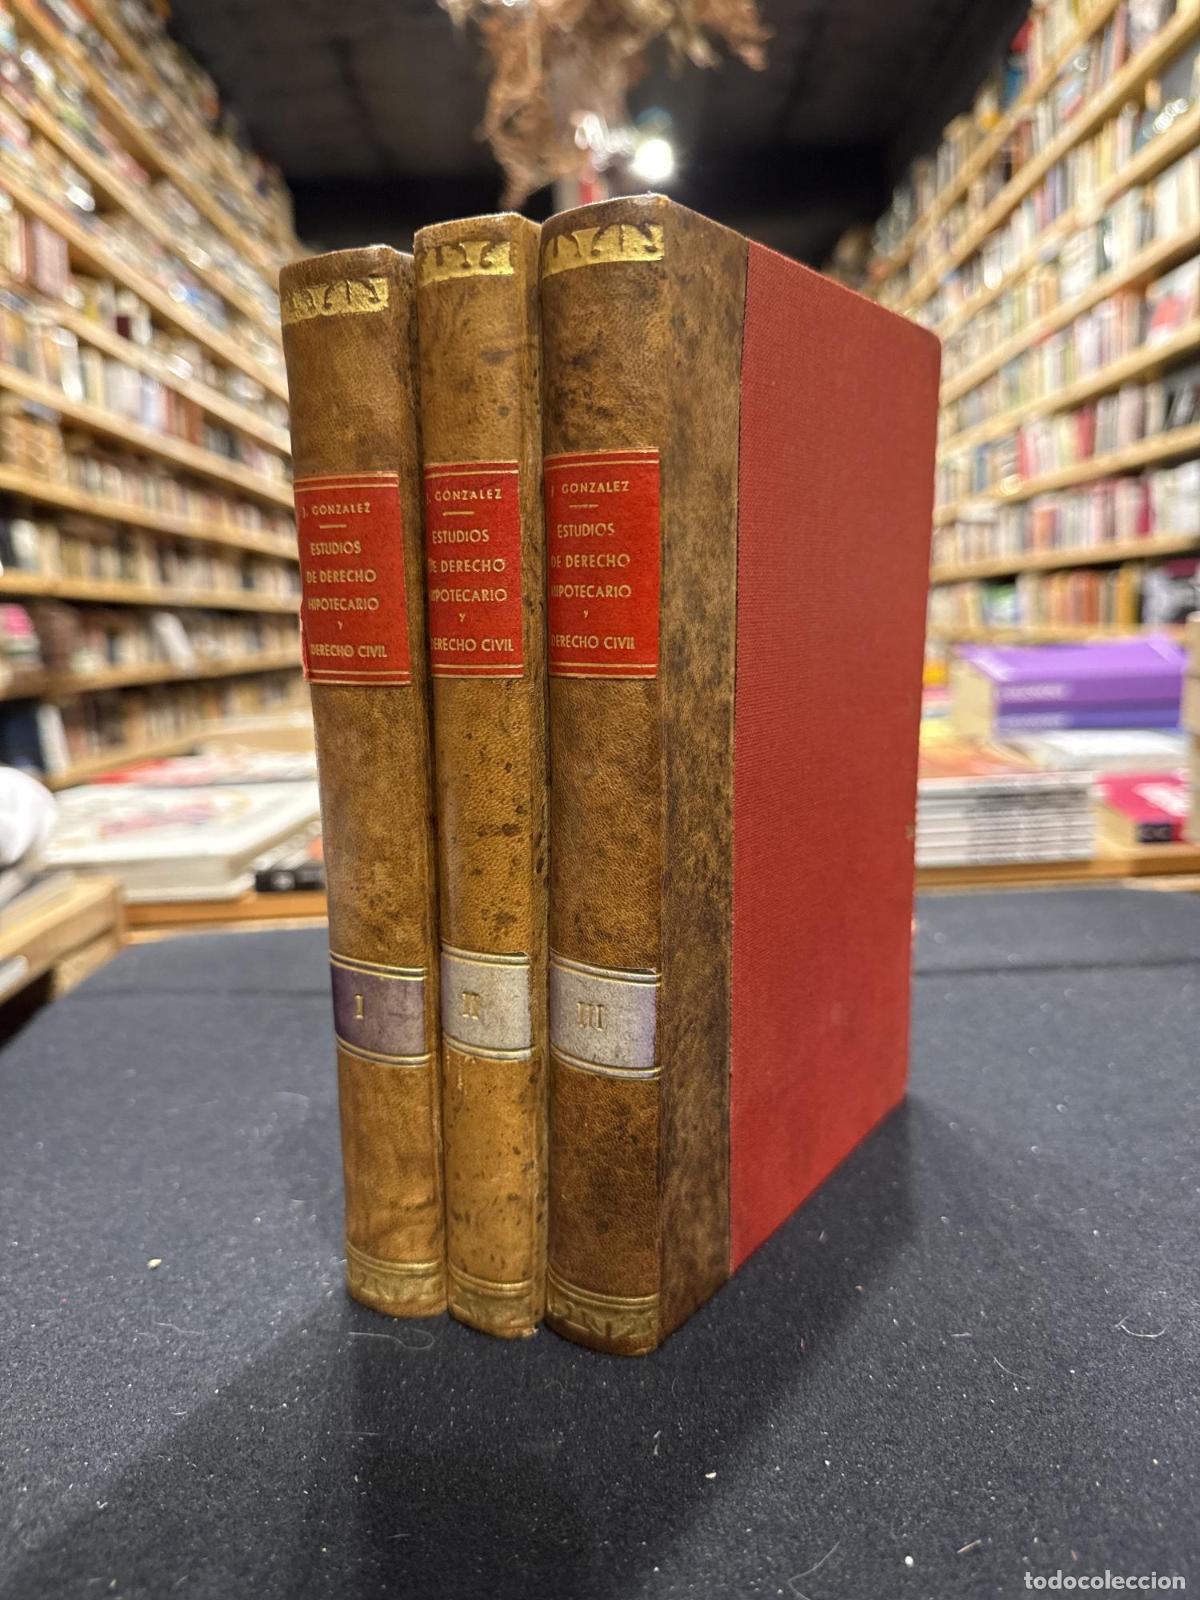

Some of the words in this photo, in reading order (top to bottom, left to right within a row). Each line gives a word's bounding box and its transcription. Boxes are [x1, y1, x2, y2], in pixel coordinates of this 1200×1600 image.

[434, 488, 502, 501] GONZALEZ
[561, 480, 630, 494] GONZALEZ
[311, 501, 371, 516] GONZALEZ
[432, 528, 490, 544] ESTUDIOS
[557, 523, 615, 539] ESTUDIOS
[310, 540, 362, 556] ESTUDIOS
[440, 558, 505, 573] DERECHO
[551, 554, 562, 568] DE
[565, 553, 631, 568] DERECHO
[306, 569, 317, 584] DE
[320, 569, 377, 584] DERECHO
[308, 597, 379, 611] HIPOTECARIO
[481, 638, 514, 652] CIVIL
[603, 636, 636, 650] CIVIL
[310, 644, 354, 658] DERECHO
[358, 644, 388, 658] CIVIL
[354, 993, 364, 1019] I
[461, 991, 481, 1020] II
[576, 1001, 604, 1031] III
